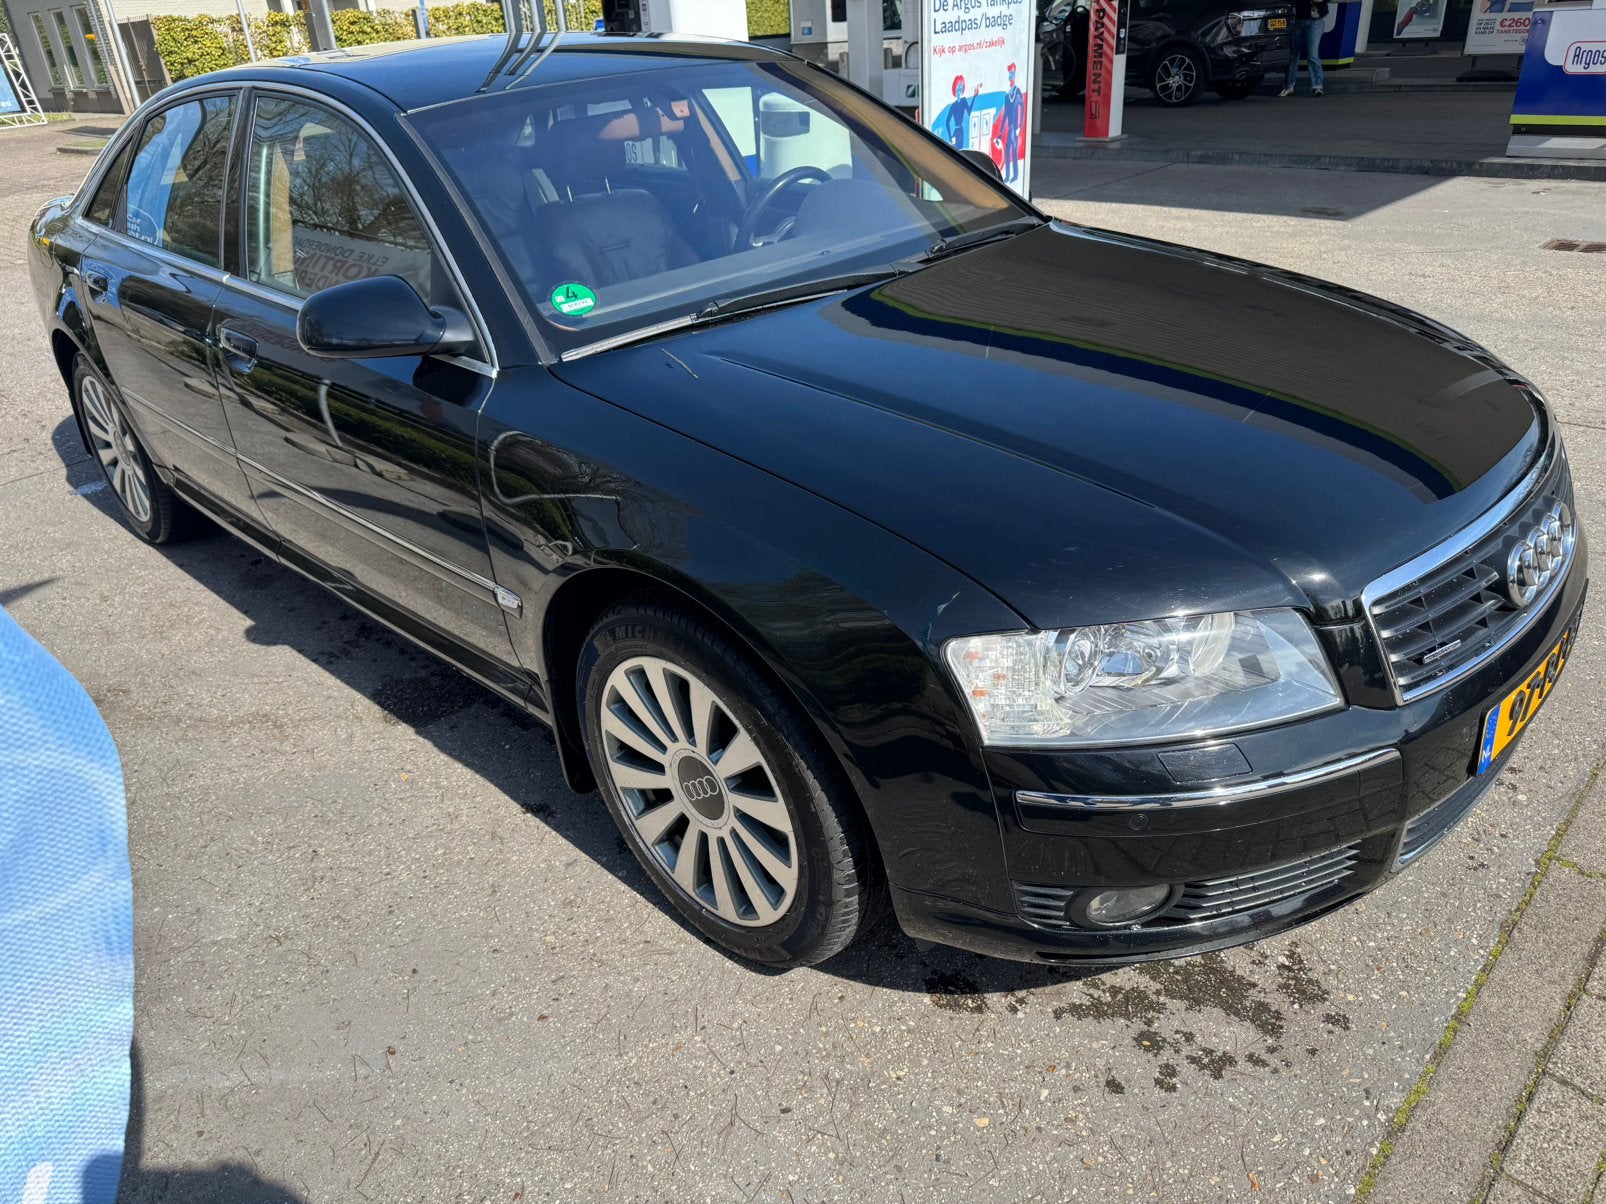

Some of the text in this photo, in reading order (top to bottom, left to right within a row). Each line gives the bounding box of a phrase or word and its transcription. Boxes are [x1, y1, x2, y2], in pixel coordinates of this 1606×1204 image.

[933, 0, 949, 13] De
[952, 0, 982, 14] Argos
[933, 11, 1014, 35] Laadpas/badge
[1499, 17, 1531, 28] €260
[933, 36, 1006, 58] Kijk op argos.nl/zakelijk
[1091, 8, 1106, 97] PAYMENT
[1571, 46, 1606, 70] Argos
